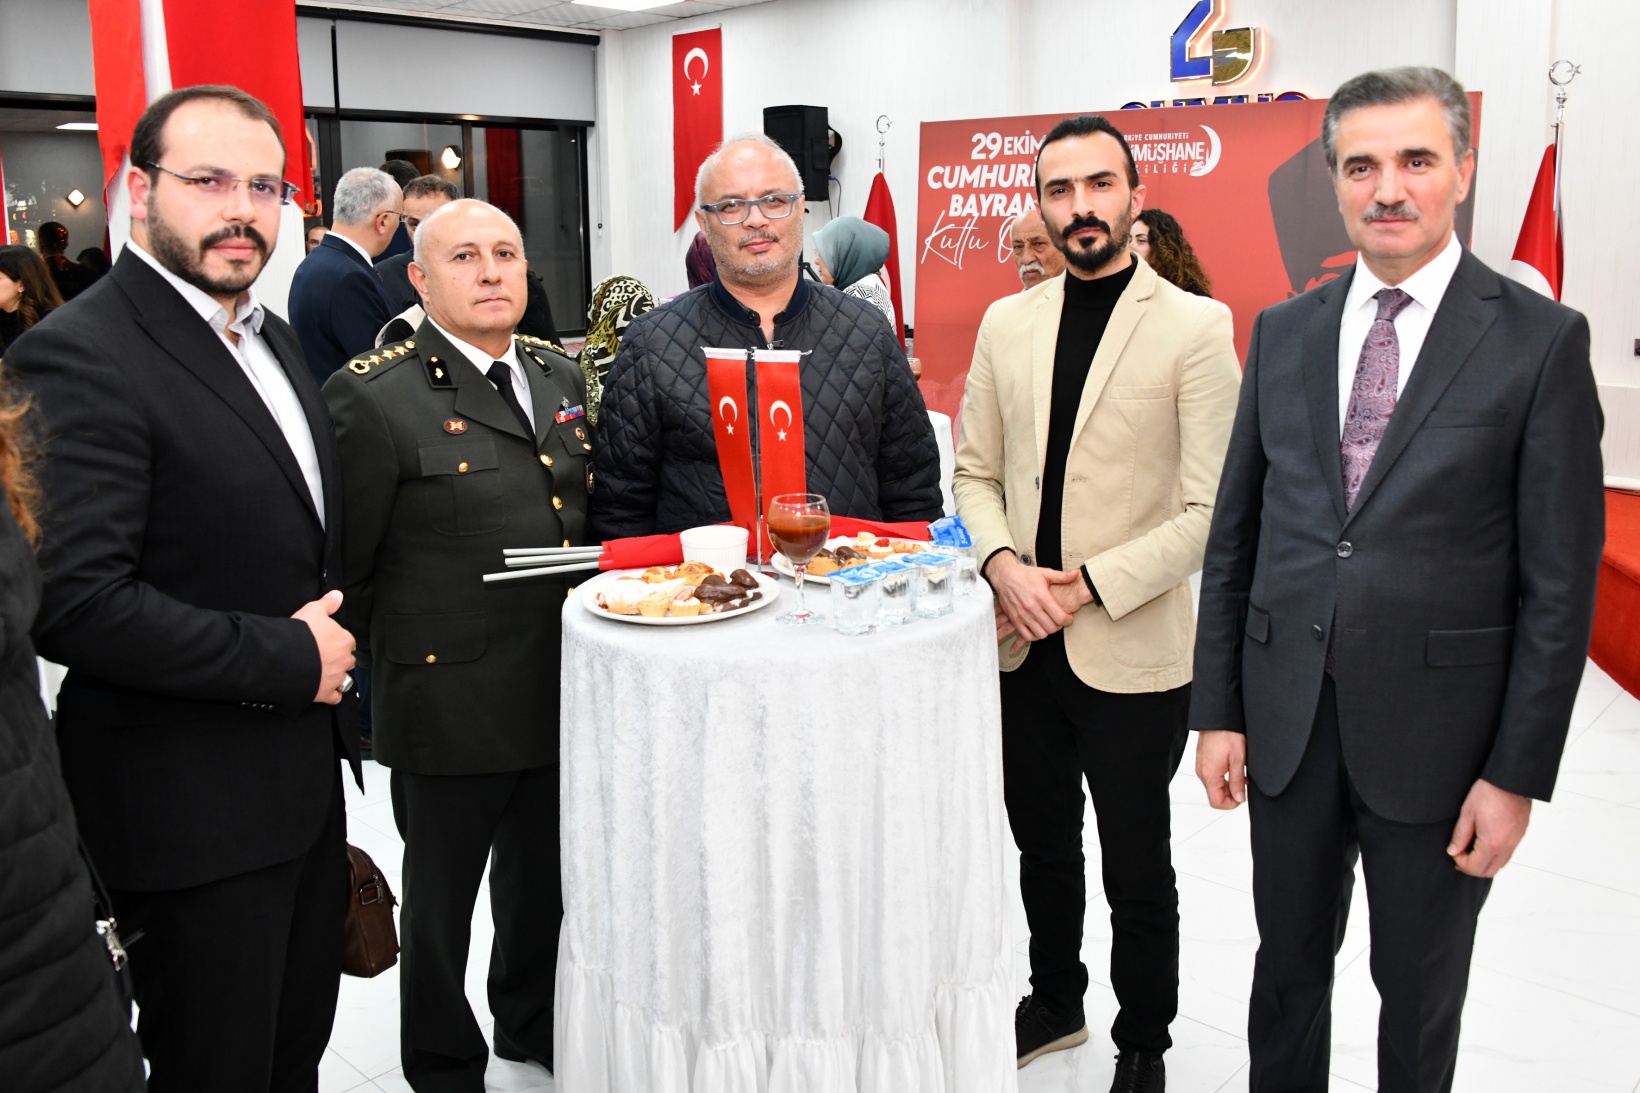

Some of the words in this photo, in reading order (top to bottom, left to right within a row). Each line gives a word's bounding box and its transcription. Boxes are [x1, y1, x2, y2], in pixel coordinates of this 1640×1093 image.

[971, 131, 1003, 160] 29
[1003, 130, 1048, 155] EKİM
[1144, 131, 1189, 141] CUMHURİYETİ
[920, 209, 989, 270] Kutlu
